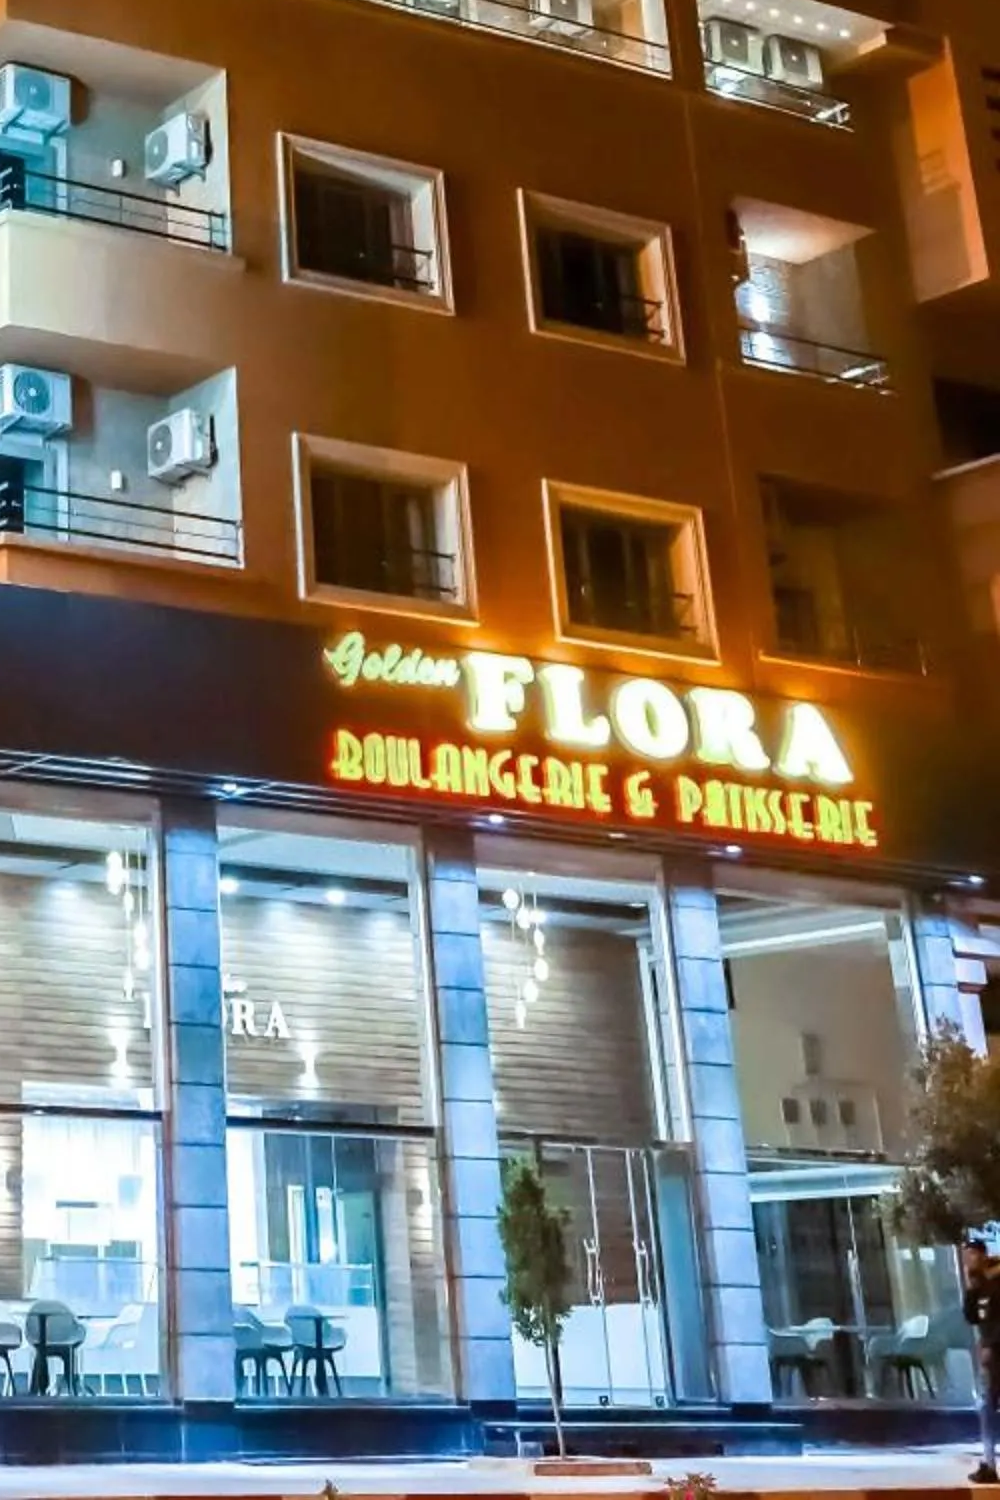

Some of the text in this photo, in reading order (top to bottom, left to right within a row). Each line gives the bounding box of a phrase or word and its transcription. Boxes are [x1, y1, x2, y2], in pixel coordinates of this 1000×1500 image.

[324, 631, 855, 785] Golden FLORA
[332, 729, 878, 847] BOULANGERIE & PATISSERIE
